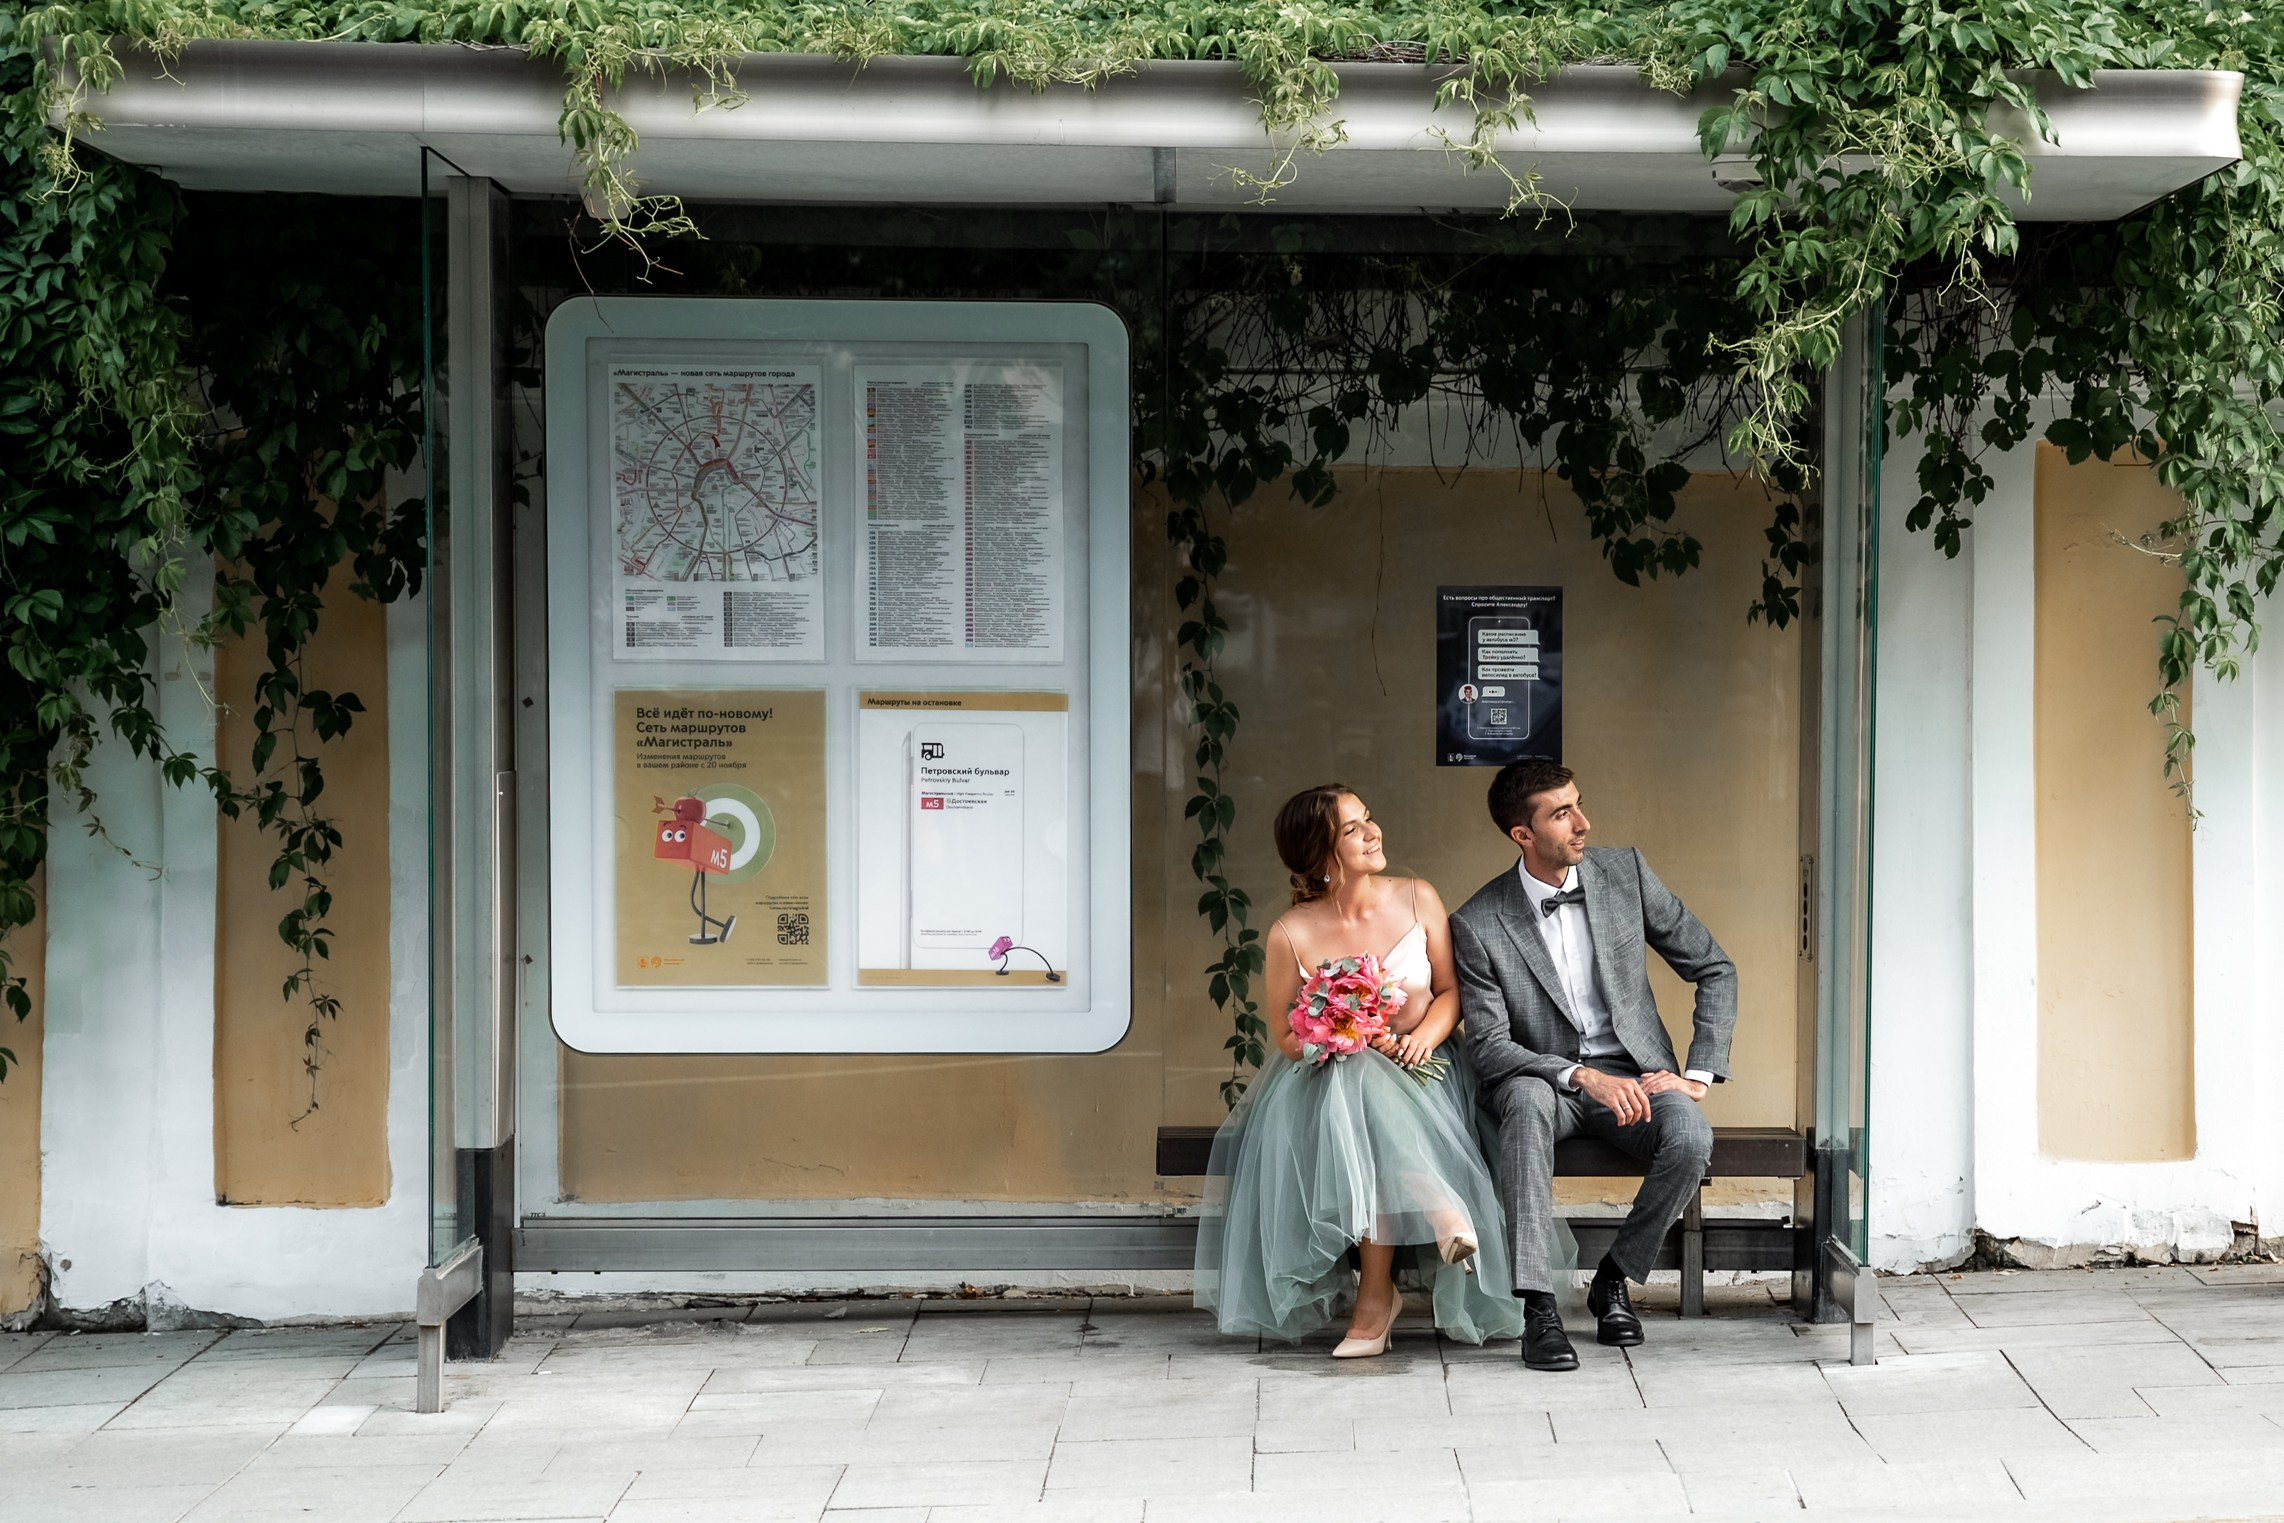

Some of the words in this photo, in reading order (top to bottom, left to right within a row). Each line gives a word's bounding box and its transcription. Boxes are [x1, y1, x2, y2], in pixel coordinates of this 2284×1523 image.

[613, 369, 669, 378] «Магистраль»
[723, 370, 767, 379] маршрутов
[768, 370, 796, 379] города
[867, 698, 911, 707] Маршруты
[636, 707, 660, 719] Всё
[664, 707, 695, 720] идёт
[698, 708, 773, 722] по-новому!
[636, 722, 667, 733] Сеть
[670, 724, 747, 736] маршрутов
[636, 736, 733, 749] «Магистраль»
[682, 754, 726, 763] маршрутов
[671, 762, 699, 772] районе
[719, 761, 747, 772] ноября
[921, 767, 973, 776] Петровский
[974, 767, 1010, 777] бульвар
